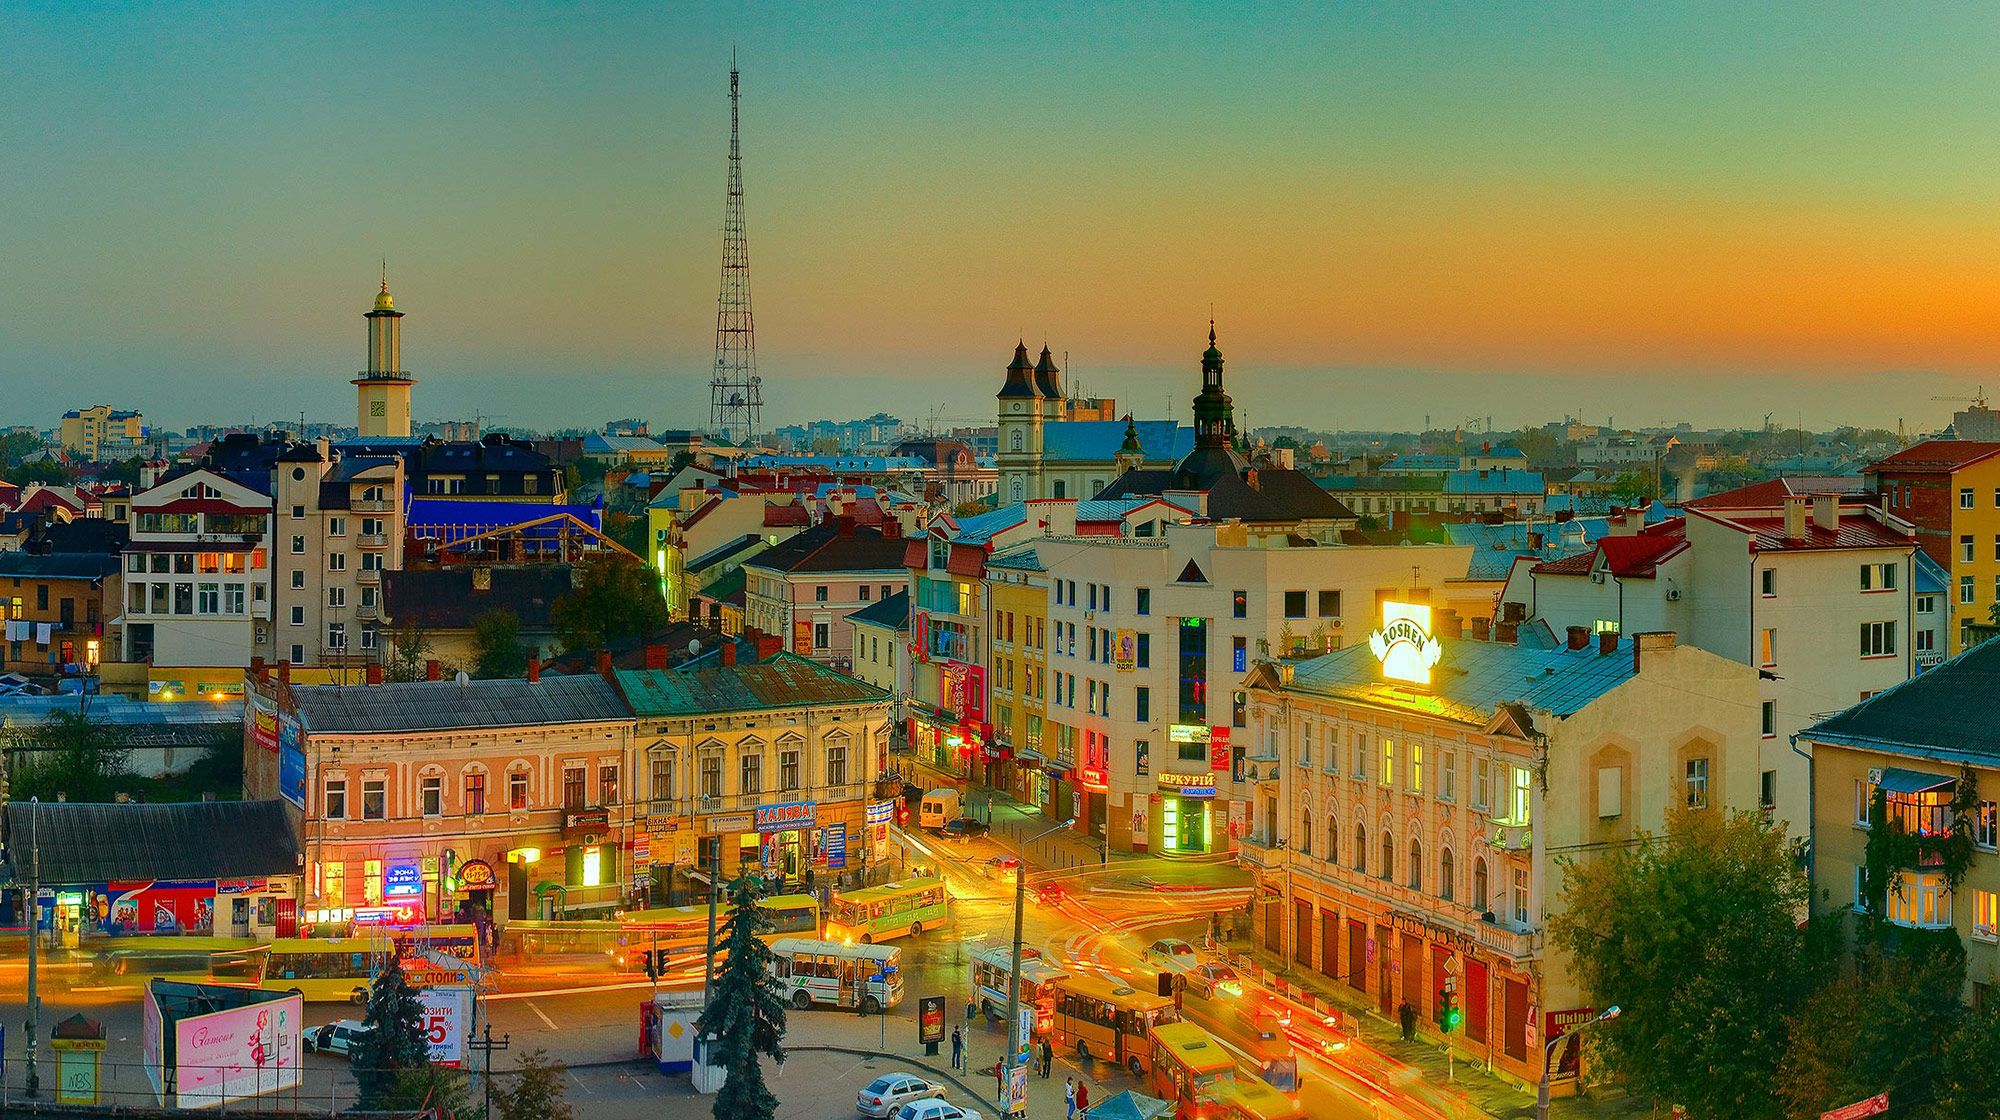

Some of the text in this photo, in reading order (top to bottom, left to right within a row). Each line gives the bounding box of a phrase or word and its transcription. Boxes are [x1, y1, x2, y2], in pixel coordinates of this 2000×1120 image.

[1383, 624, 1425, 652] ROSHEN
[1158, 772, 1215, 786] МЕРКУРІЙ
[1181, 787, 1216, 795] КОМПЛЕКС
[647, 817, 668, 826] ВІКНА
[425, 972, 457, 984] СТОЛИ
[423, 1007, 453, 1016] ОЗИТИ
